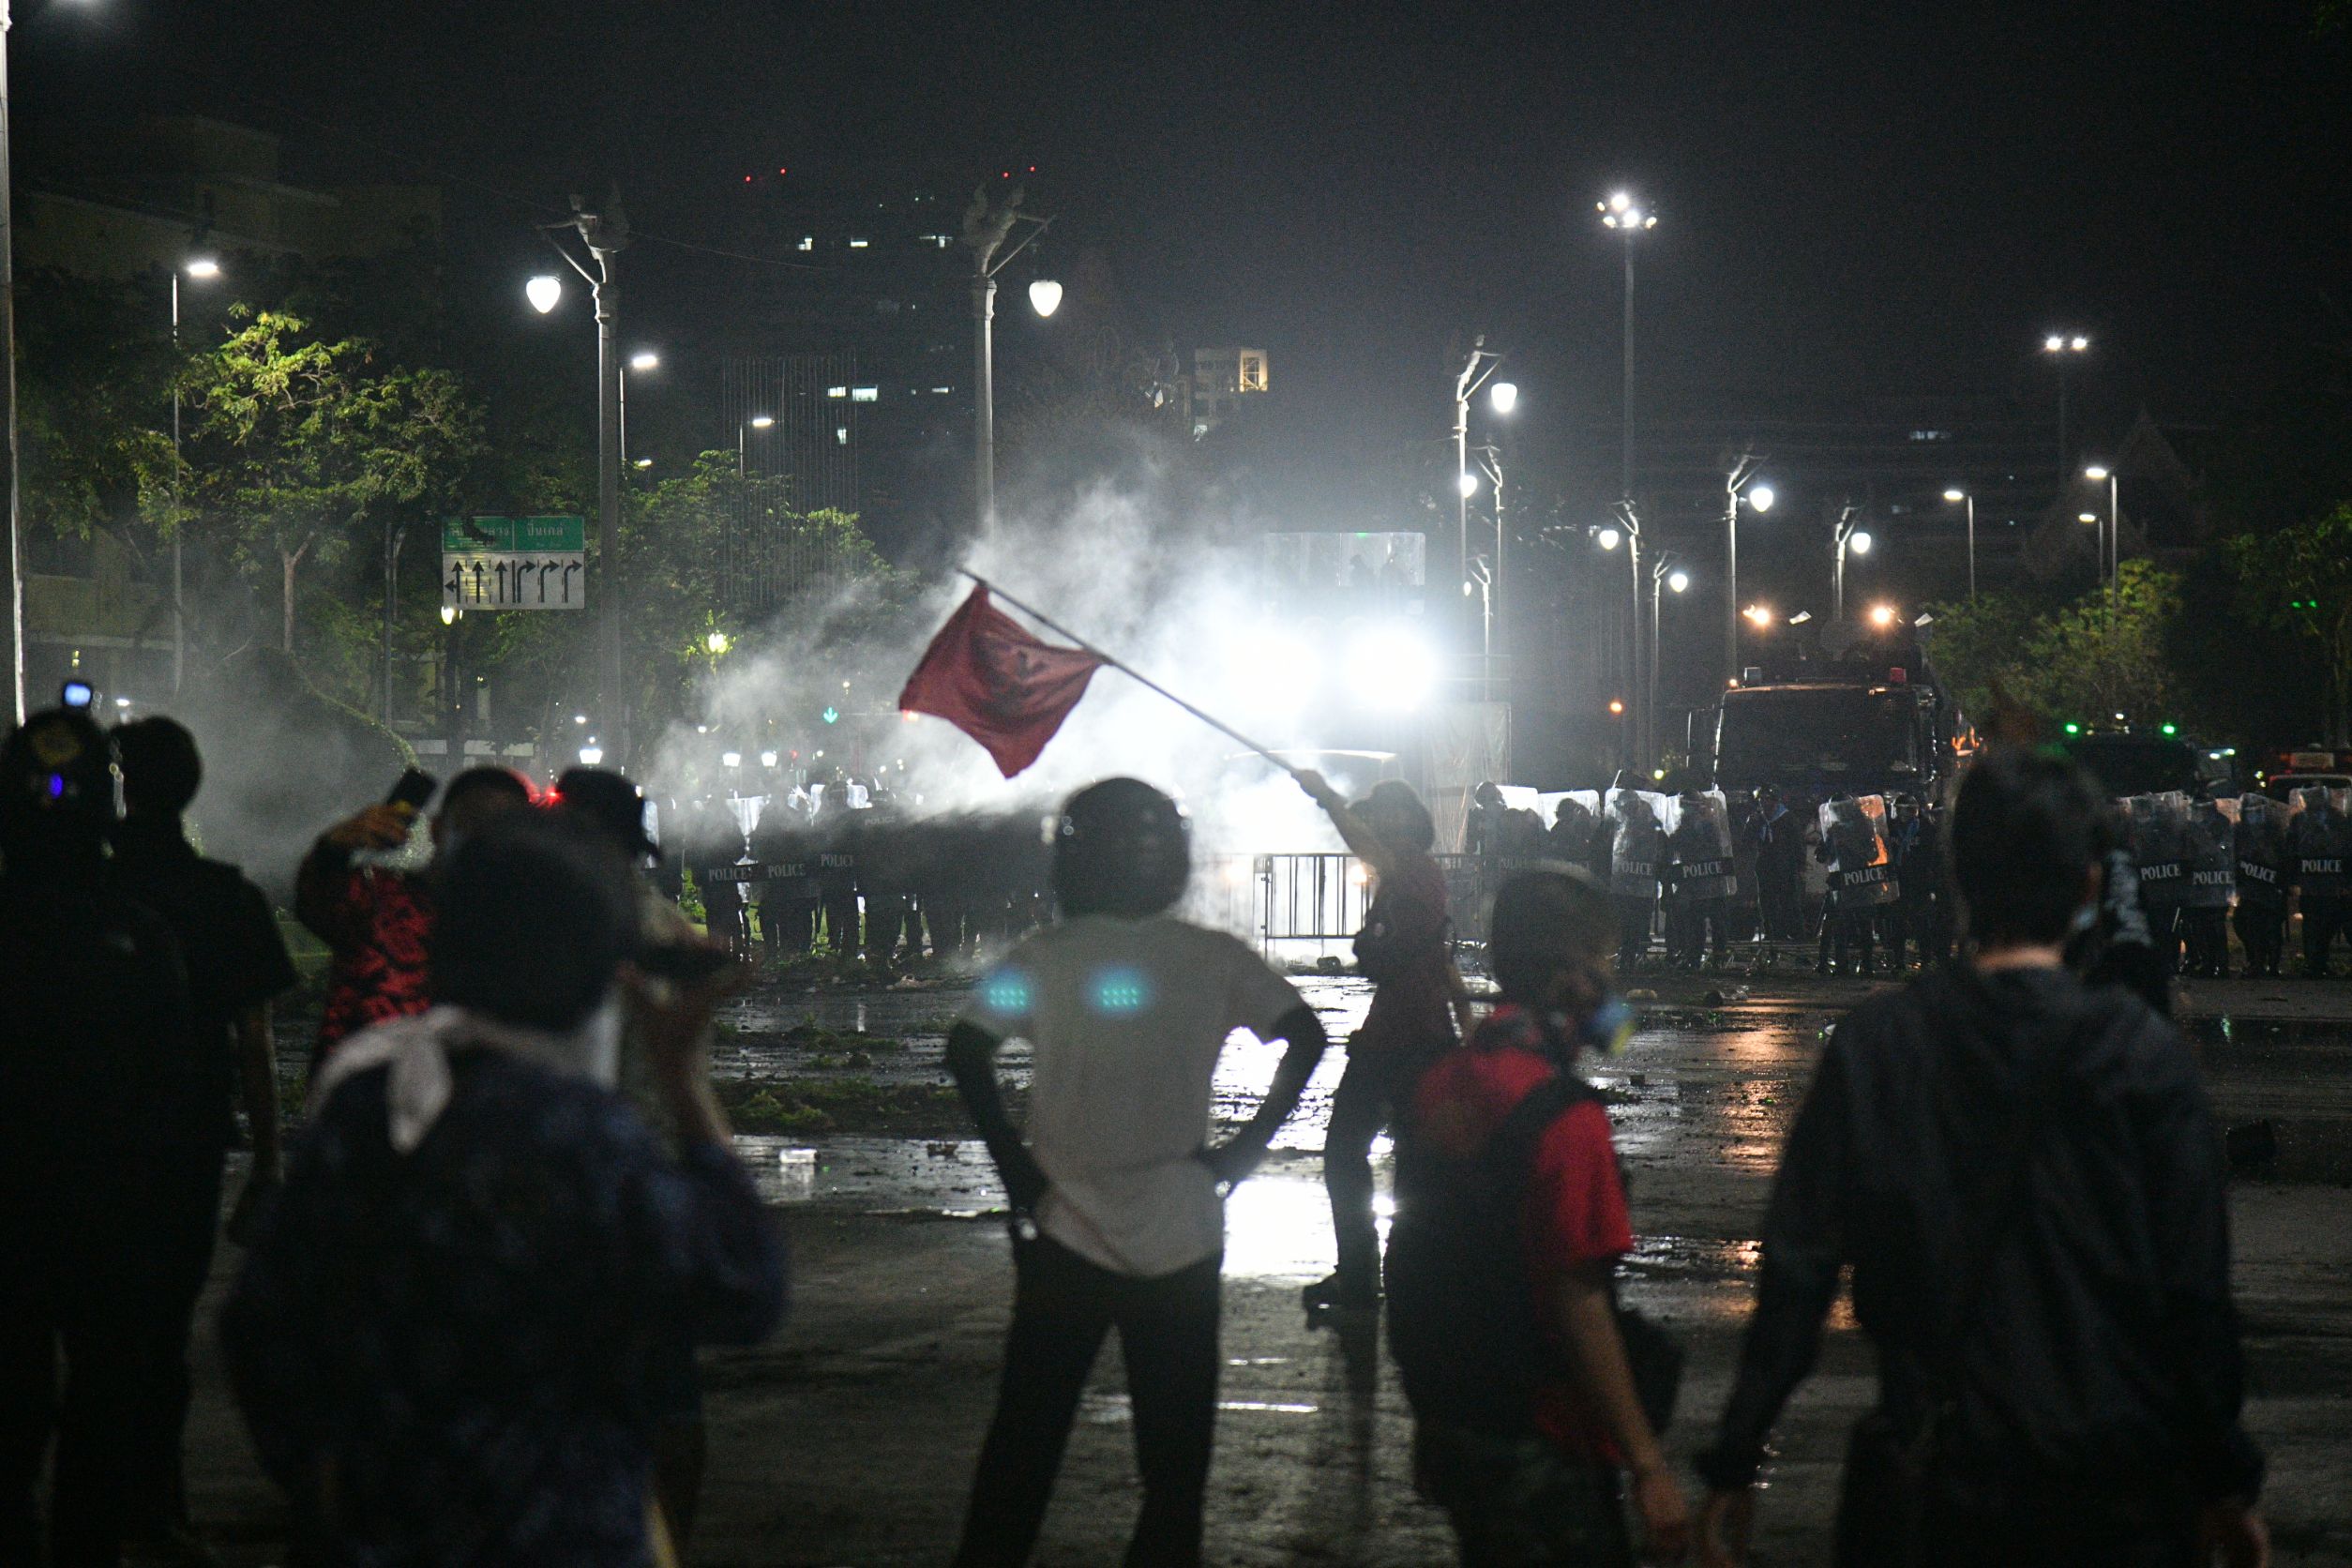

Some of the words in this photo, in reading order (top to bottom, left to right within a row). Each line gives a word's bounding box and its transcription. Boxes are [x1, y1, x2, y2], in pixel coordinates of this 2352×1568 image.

[1681, 860, 1723, 878] POLICE
[2140, 863, 2181, 881] POLICE
[2300, 858, 2343, 873] POLICE
[709, 867, 747, 882] POLICE
[1844, 867, 1884, 885] POLICE
[2192, 870, 2233, 885] POLICE
